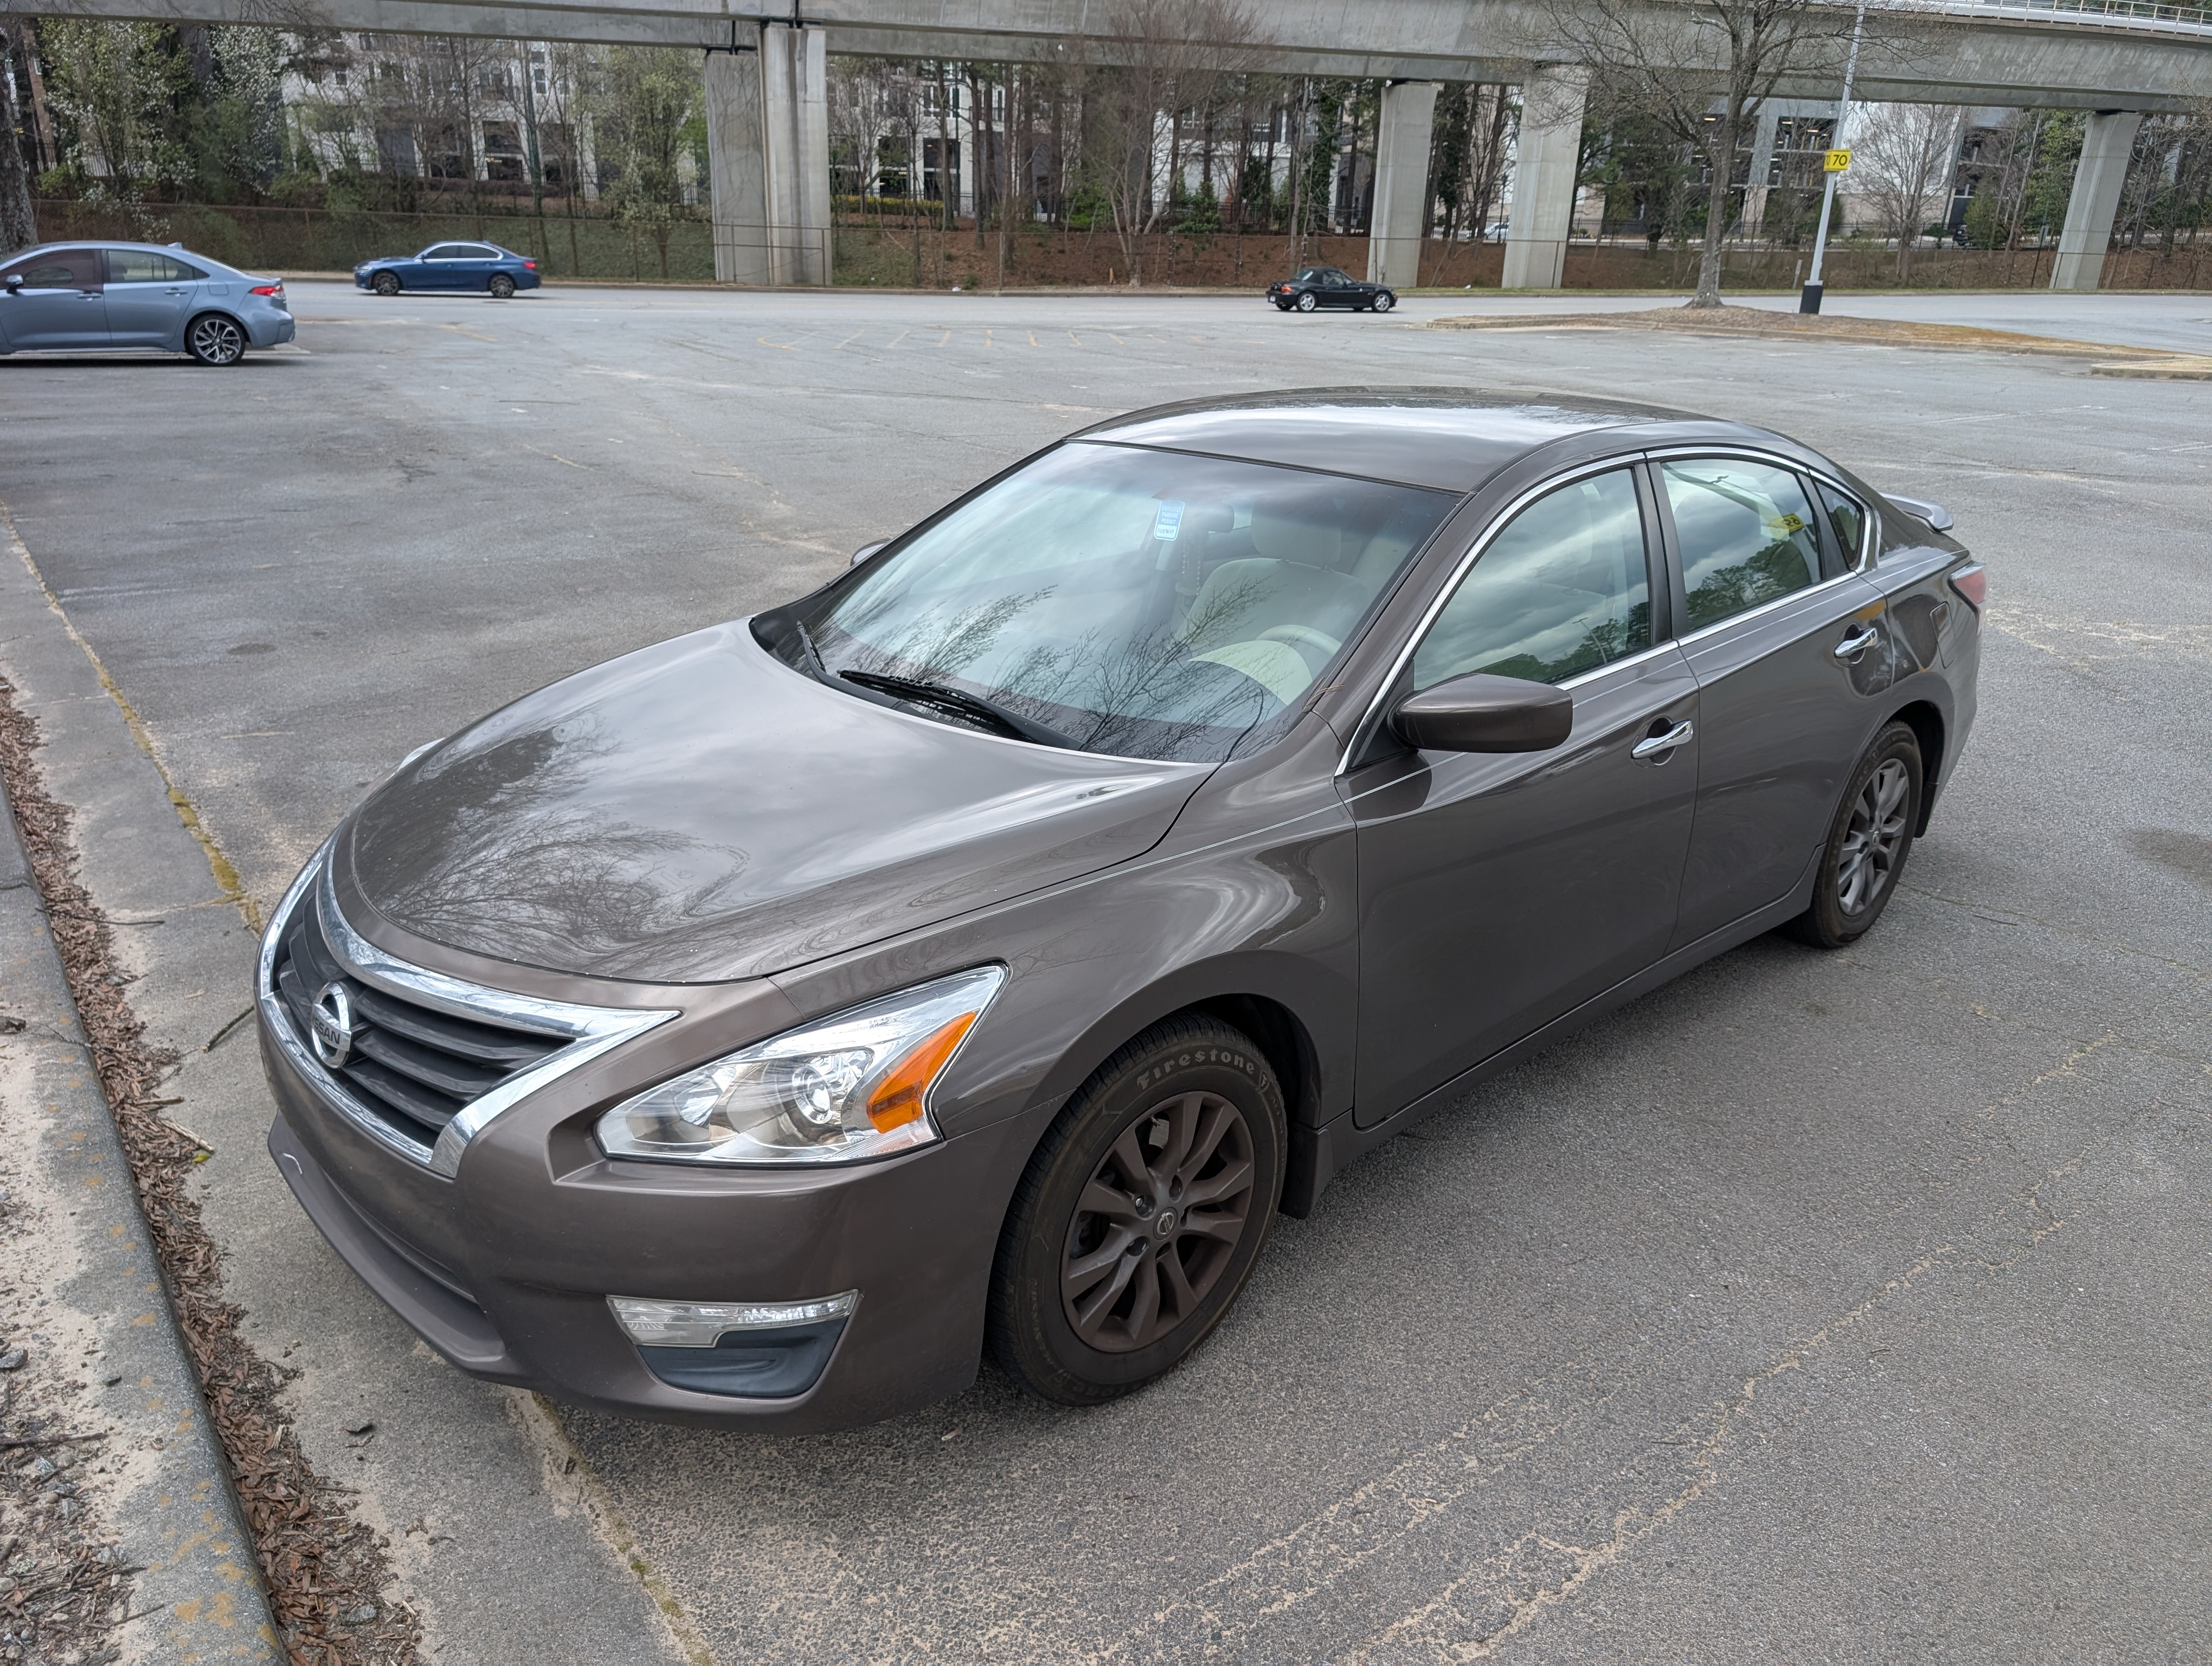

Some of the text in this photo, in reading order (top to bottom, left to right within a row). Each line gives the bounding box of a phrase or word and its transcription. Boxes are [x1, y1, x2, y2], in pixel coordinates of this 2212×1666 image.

[1832, 155, 1848, 166] 70
[313, 1014, 340, 1045] ISSAN
[1136, 1048, 1255, 1091] Firestone
